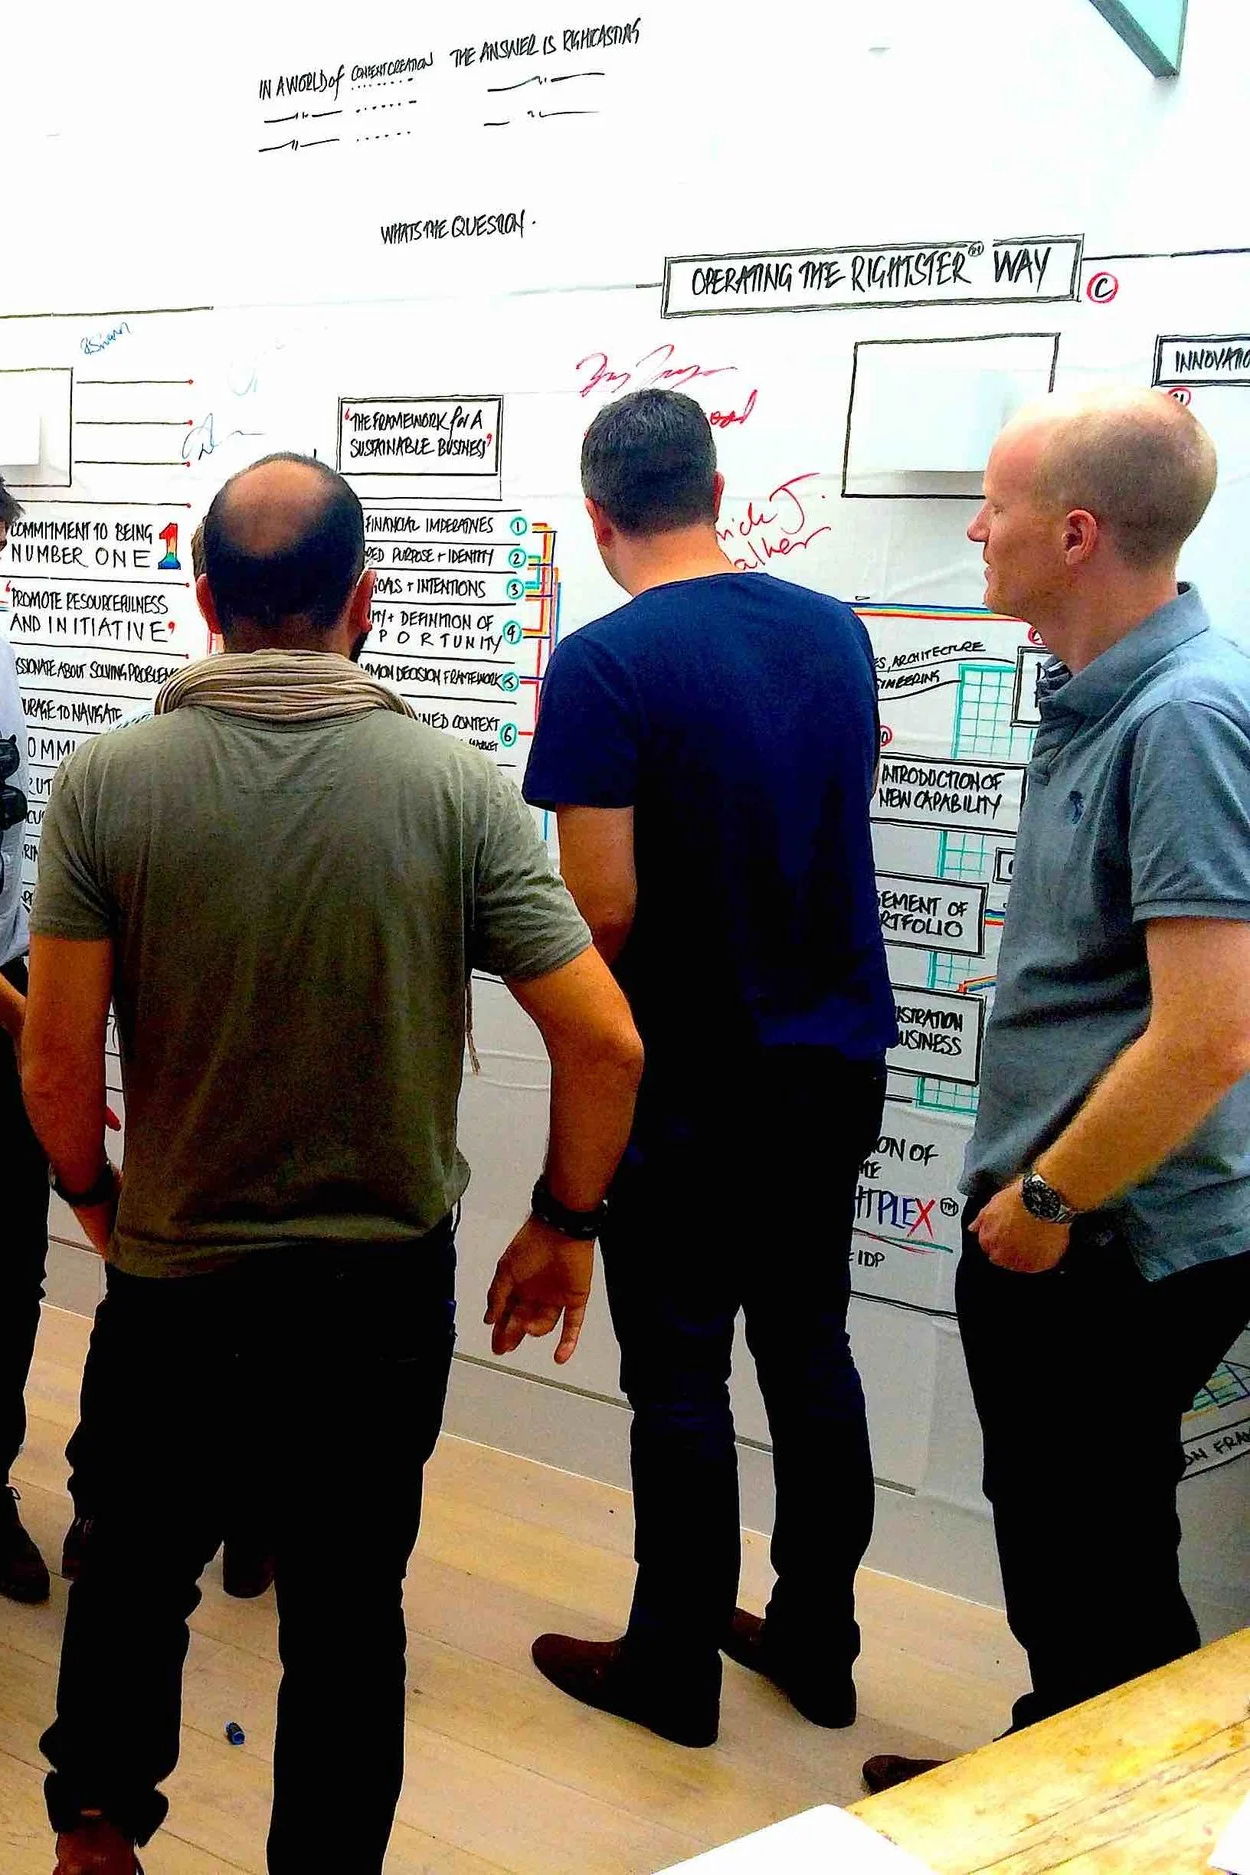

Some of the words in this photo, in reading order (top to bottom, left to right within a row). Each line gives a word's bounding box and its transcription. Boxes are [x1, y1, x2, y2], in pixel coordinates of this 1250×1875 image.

[450, 47, 476, 67] THE
[480, 34, 539, 63] ANSWER
[543, 35, 557, 55] IS
[259, 79, 271, 100] IN
[286, 69, 327, 95] WORLD
[692, 262, 793, 296] OPERATING
[799, 260, 846, 291] THE
[851, 249, 971, 293] RIGHTSTER
[993, 246, 1052, 293] WAY
[470, 409, 483, 430] A
[10, 520, 90, 542] COMMITMENT
[93, 524, 108, 542] TO
[115, 521, 153, 545] BEING
[11, 543, 89, 568] NUMBER
[95, 547, 151, 568] ONE
[392, 546, 435, 563] PURPOSE
[448, 548, 494, 566] IDENTITY
[417, 577, 487, 599] INTENTIONS
[10, 613, 41, 632] AND
[401, 611, 471, 631] DEFINITION
[476, 614, 495, 632] OF
[892, 641, 986, 668] ARCHITECTURE
[57, 661, 86, 679] ABOUT
[89, 660, 127, 682] SOLVING
[452, 714, 501, 732] CONTEXT
[881, 763, 981, 792] INTRODUCTION
[981, 772, 1006, 792] OF
[878, 788, 913, 809] NEW
[913, 792, 1003, 820] CAPABILITY
[947, 901, 969, 918] OF
[909, 1143, 940, 1166] OF
[857, 1250, 886, 1268] IDP
